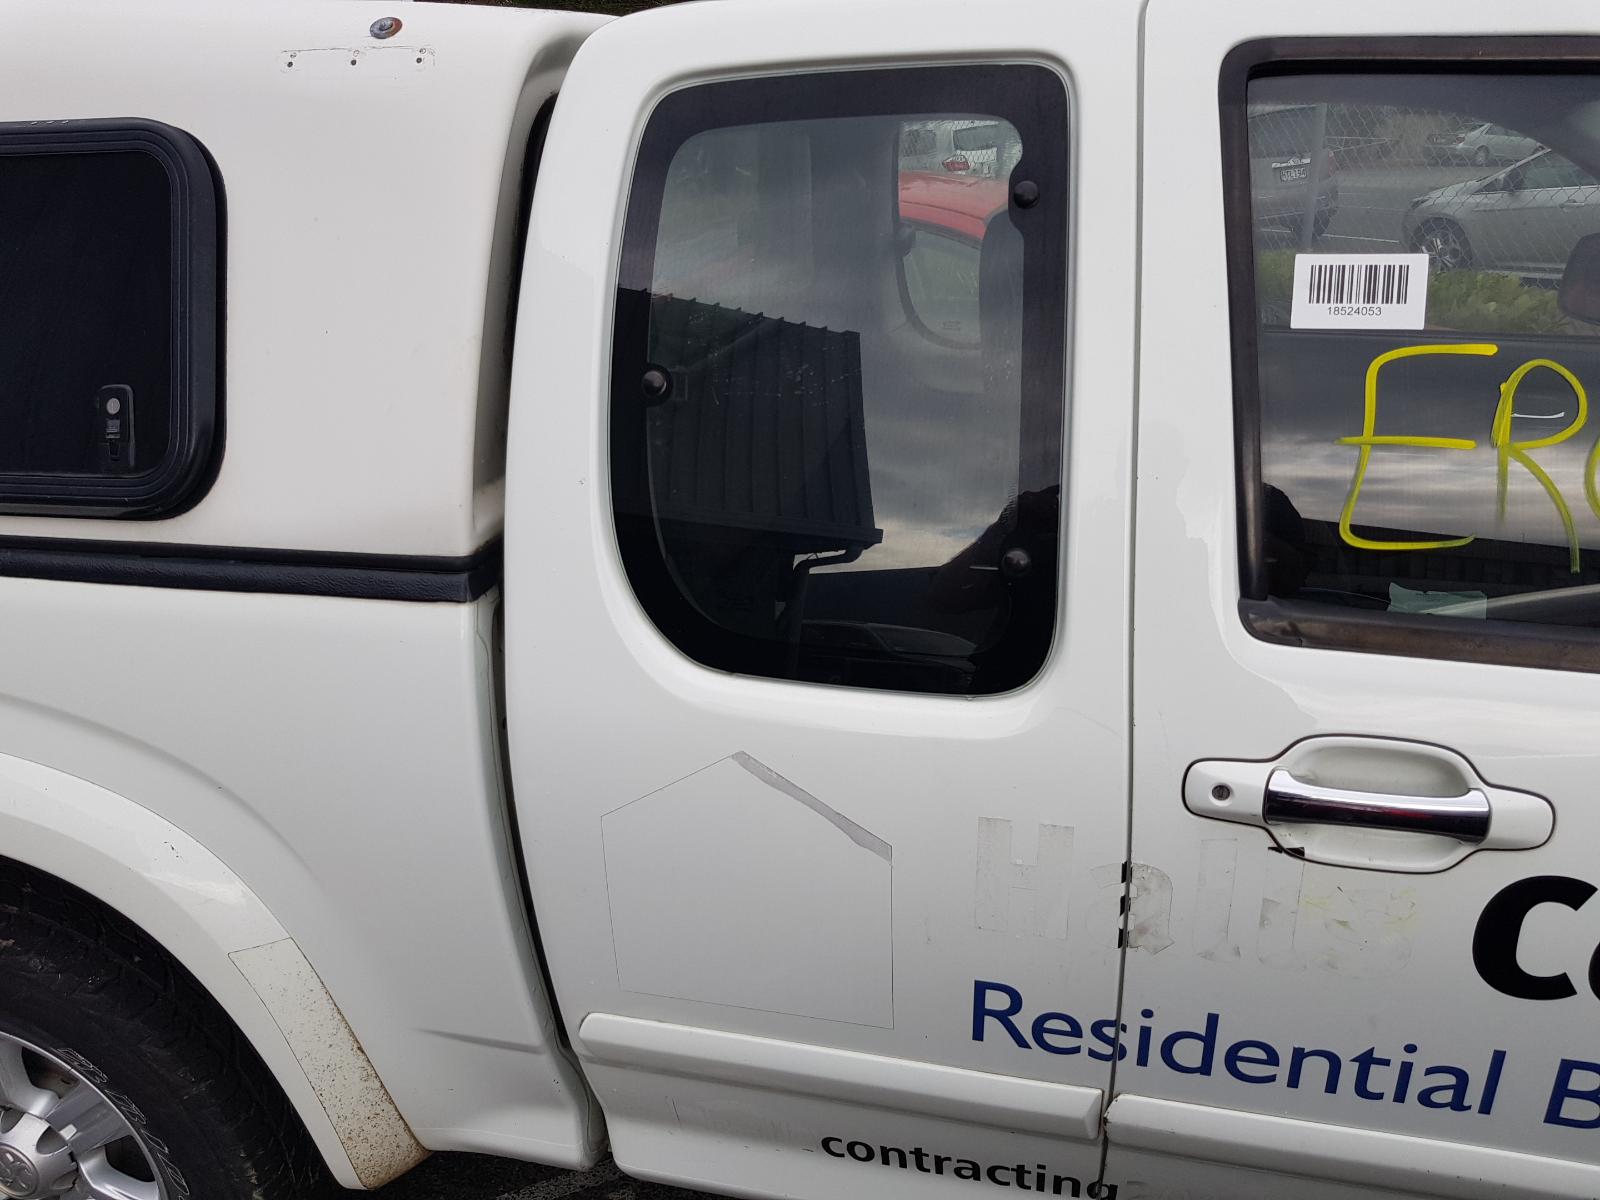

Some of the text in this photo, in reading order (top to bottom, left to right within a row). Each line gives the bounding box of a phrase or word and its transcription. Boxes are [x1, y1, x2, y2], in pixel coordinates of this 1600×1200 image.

[1327, 306, 1382, 317] 18524053
[1334, 343, 1600, 574] ER
[1472, 875, 1600, 1001] C
[972, 979, 1506, 1116] Residential
